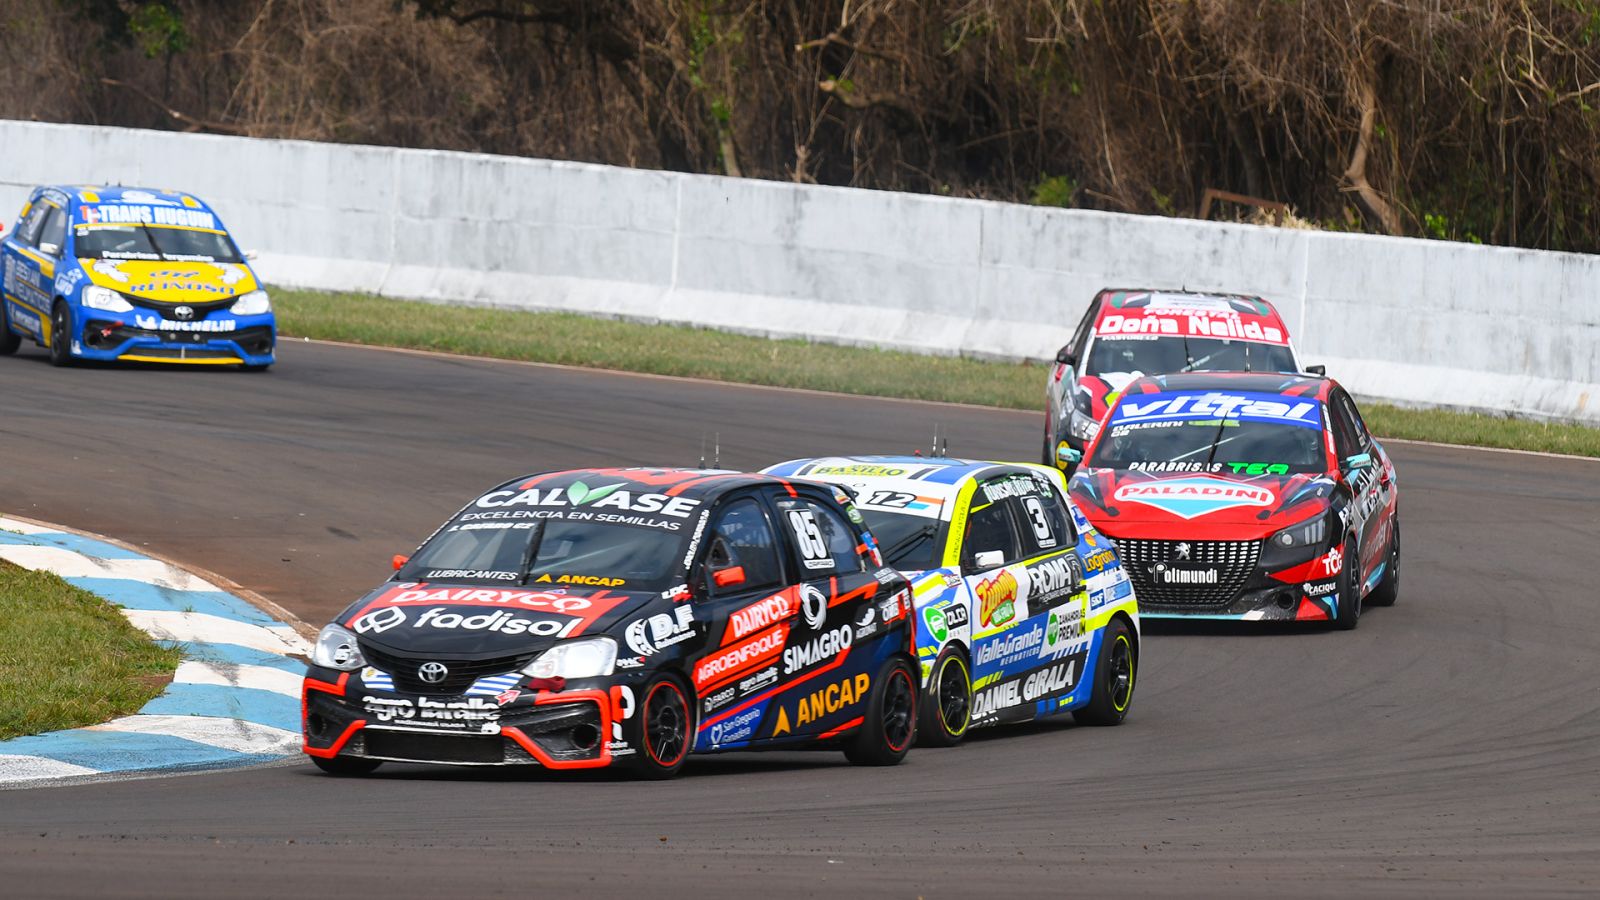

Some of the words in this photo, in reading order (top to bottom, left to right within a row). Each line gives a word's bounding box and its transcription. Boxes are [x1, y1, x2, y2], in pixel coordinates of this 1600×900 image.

[98, 205, 153, 223] TRANS
[154, 206, 215, 229] HUGUIN
[1100, 315, 1178, 334] Doña
[1144, 307, 1240, 320] FORESTAL
[160, 319, 236, 332] MICHELIN
[815, 466, 905, 476] BASILIO
[1227, 463, 1290, 475] TEA
[476, 486, 701, 519] CALVASE
[865, 490, 918, 509] 12
[1122, 486, 1268, 502] PALADINI
[460, 510, 563, 521] EXCELENCIA
[567, 511, 591, 520] EN
[595, 513, 682, 531] SEMILLAS
[1026, 498, 1050, 540] 3
[788, 510, 827, 559] 85
[1148, 562, 1218, 584] Polimundi
[1322, 553, 1342, 575] TCG
[427, 570, 519, 581] LUBRICANTES
[556, 575, 626, 587] ANCAP
[1028, 557, 1072, 596] ROMA
[1091, 592, 1104, 606] SKF
[1309, 582, 1336, 594] CACIQUE
[391, 589, 593, 613] DAIRYCO
[413, 607, 584, 638] fadisol
[732, 595, 789, 638] DAIRYCO
[1058, 621, 1086, 642] PREMIUM
[698, 629, 784, 684] AGROENFOQUE
[784, 624, 852, 675] SIMAGRO
[974, 679, 1021, 715] DANIEL
[1023, 660, 1076, 701] GIRALA
[796, 673, 870, 728] ANCAP
